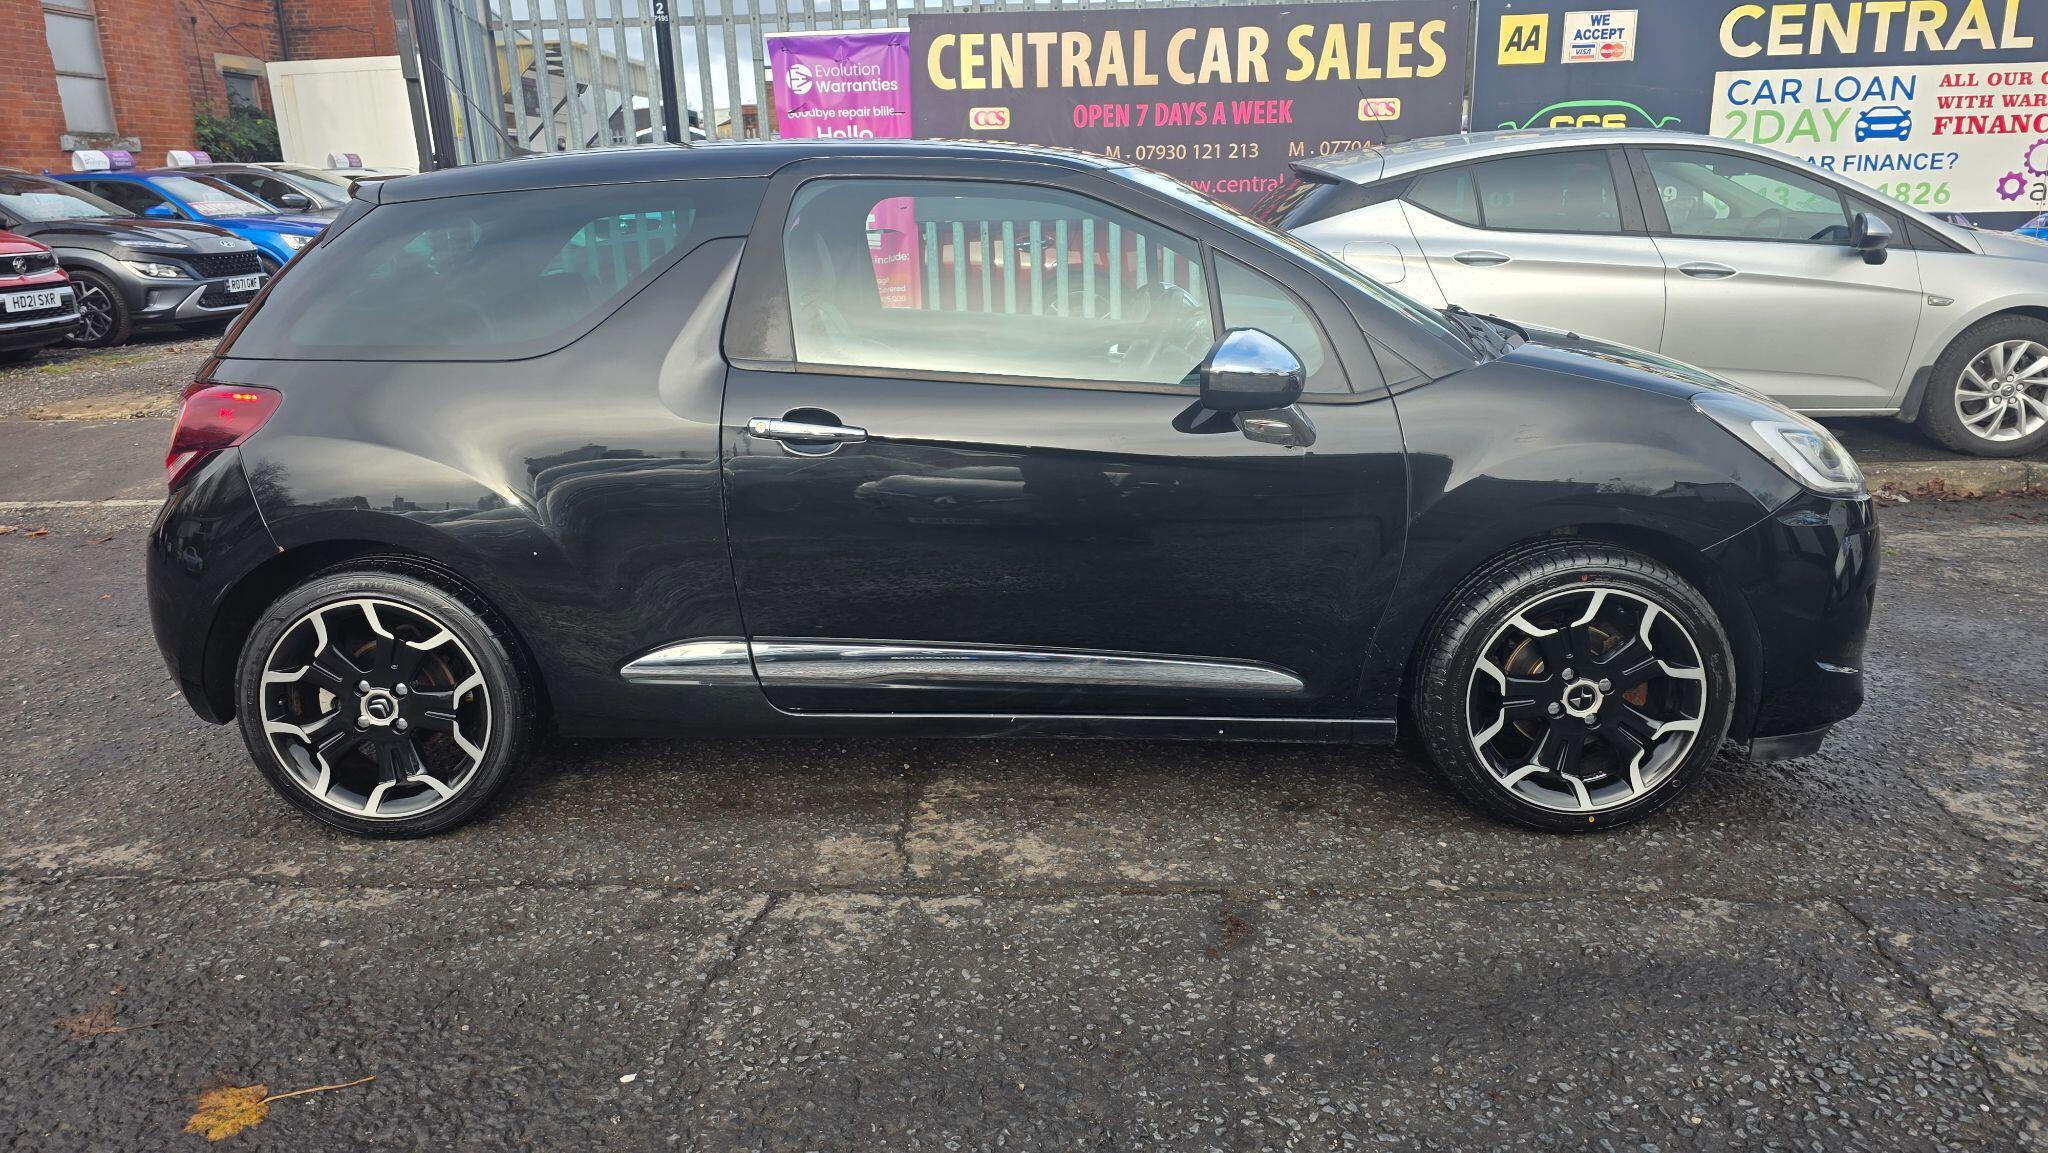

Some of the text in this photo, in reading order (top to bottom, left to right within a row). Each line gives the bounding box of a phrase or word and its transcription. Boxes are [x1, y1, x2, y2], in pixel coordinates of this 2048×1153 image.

[655, 2, 665, 15] 2
[1591, 14, 1611, 26] WE
[1574, 28, 1625, 41] ACCEPT
[1719, 0, 2034, 58] CENTRAL
[1504, 24, 1541, 53] AA
[927, 19, 1447, 91] CENTRAL CAR SALES
[815, 63, 881, 78] Evolution
[815, 78, 899, 93] Warranties
[1939, 73, 1979, 88] ALL
[1987, 72, 2034, 87] OUR
[1727, 75, 1917, 106] CAR LOAN
[1937, 95, 1995, 109] WITH
[838, 106, 871, 120] repair
[1073, 99, 1294, 128] OPEN 7 DAYS A WEEK
[1724, 107, 1852, 145] 2DAY
[1135, 143, 1187, 161] 07930
[1194, 143, 1222, 160] 121
[1228, 143, 1260, 159] 213
[1843, 152, 1959, 172] FINANCE?
[231, 279, 246, 290] RO71
[12, 292, 56, 309] HD21 SXR
